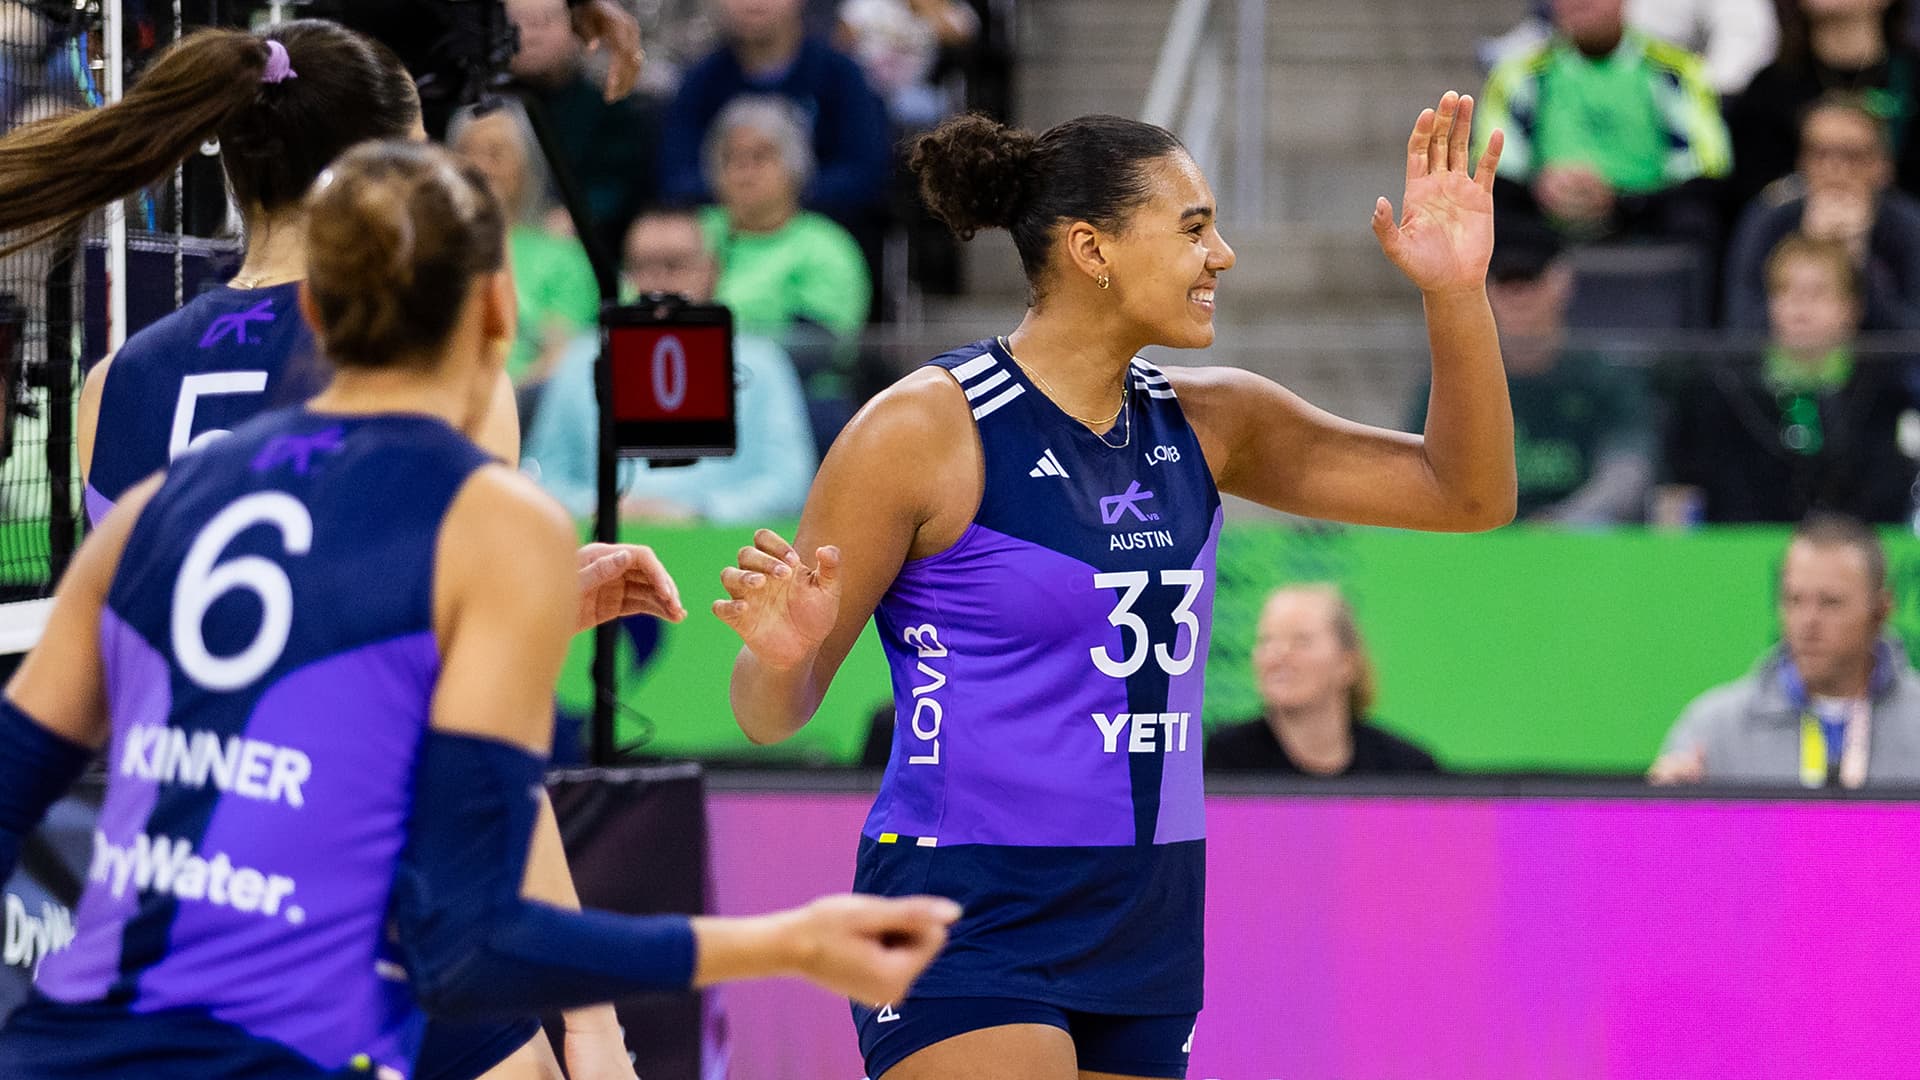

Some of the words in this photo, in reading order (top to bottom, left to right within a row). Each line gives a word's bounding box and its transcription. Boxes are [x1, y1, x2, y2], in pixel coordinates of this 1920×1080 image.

[652, 334, 687, 412] 0
[1109, 530, 1174, 552] AUSTIN
[171, 490, 313, 692] 6
[1089, 569, 1206, 679] 33
[903, 622, 949, 766] LOVB
[1091, 713, 1188, 753] YETI
[121, 722, 313, 808] KINNER
